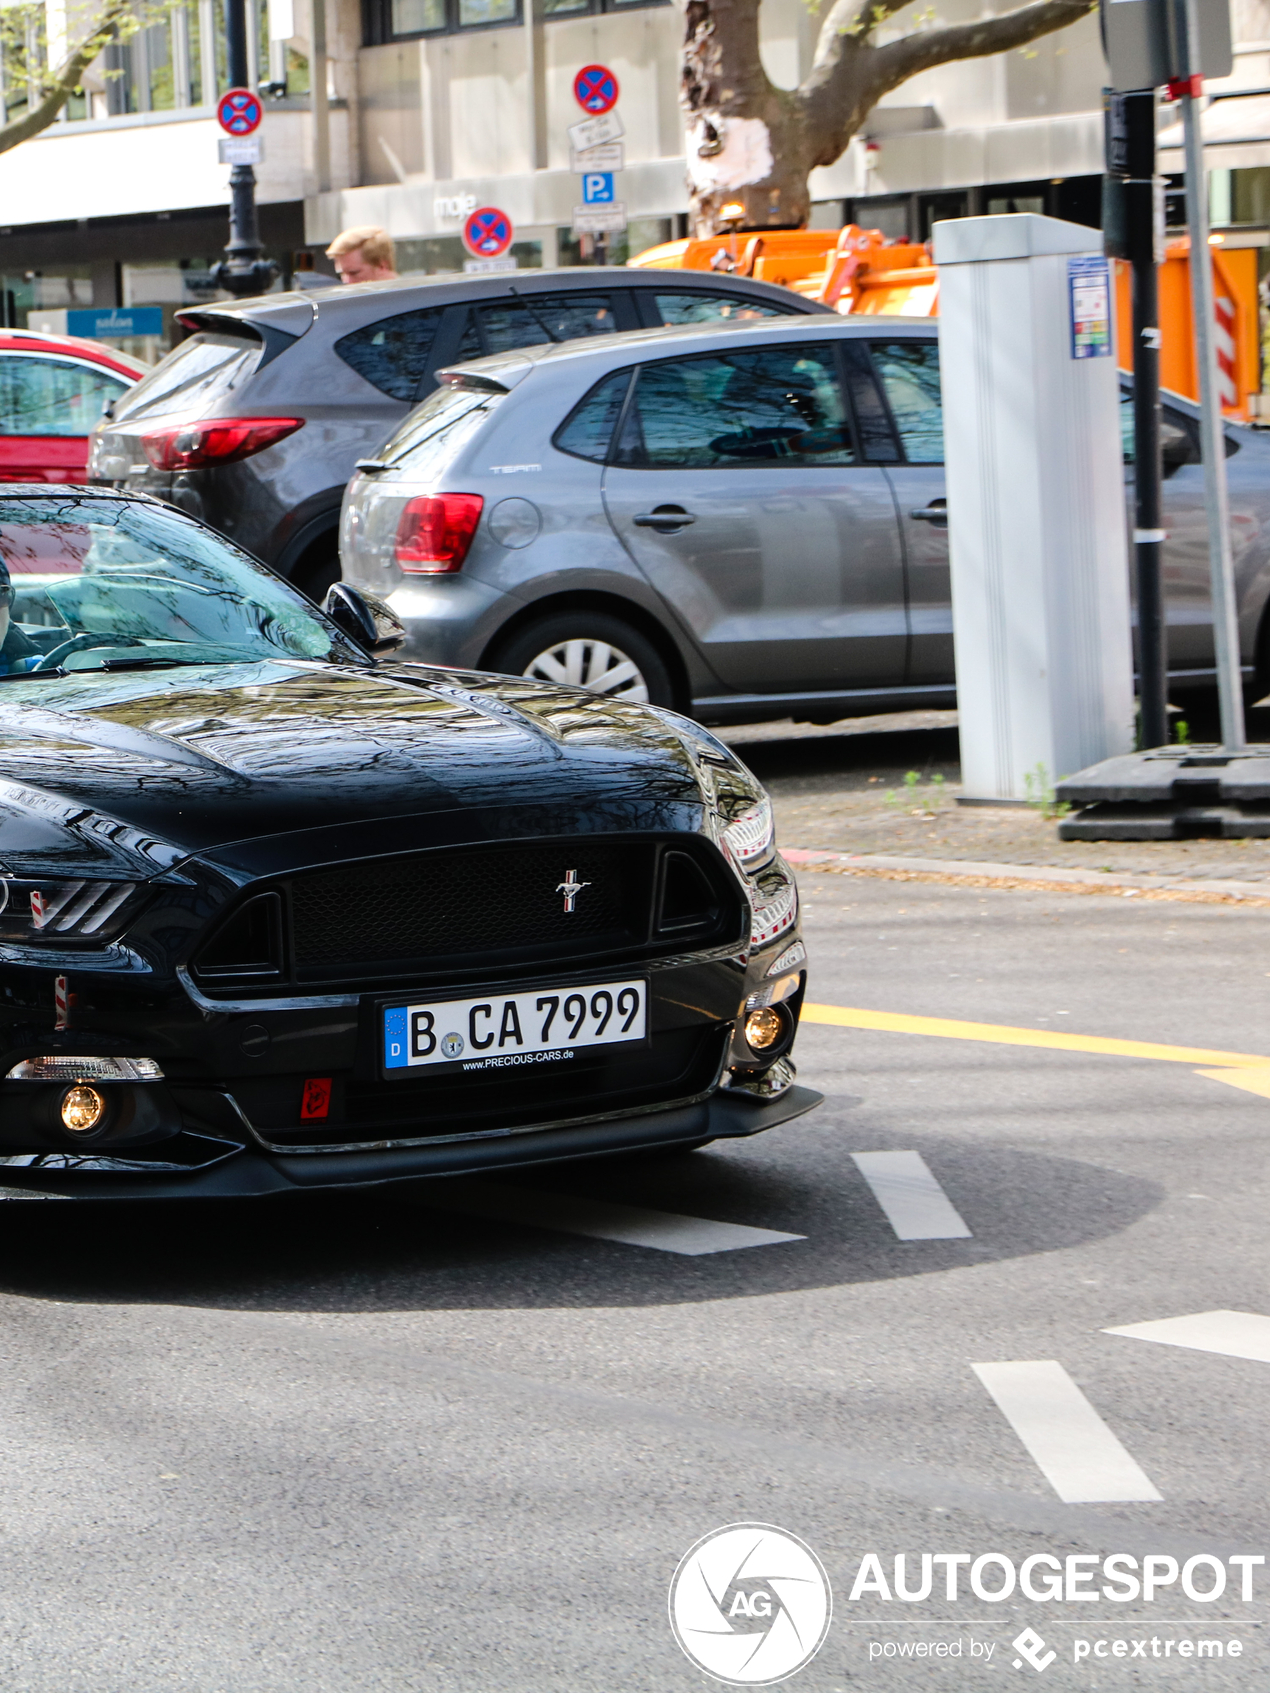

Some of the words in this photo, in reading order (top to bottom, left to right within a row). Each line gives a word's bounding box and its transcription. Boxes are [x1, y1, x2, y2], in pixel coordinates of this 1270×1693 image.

[586, 174, 606, 201] P
[489, 464, 542, 474] TEAM
[411, 1011, 436, 1057] B
[469, 1000, 524, 1050] CA
[536, 987, 640, 1043] 7999
[391, 1043, 401, 1056] D
[462, 1049, 574, 1071] www.PRECIOUS-CARS.de
